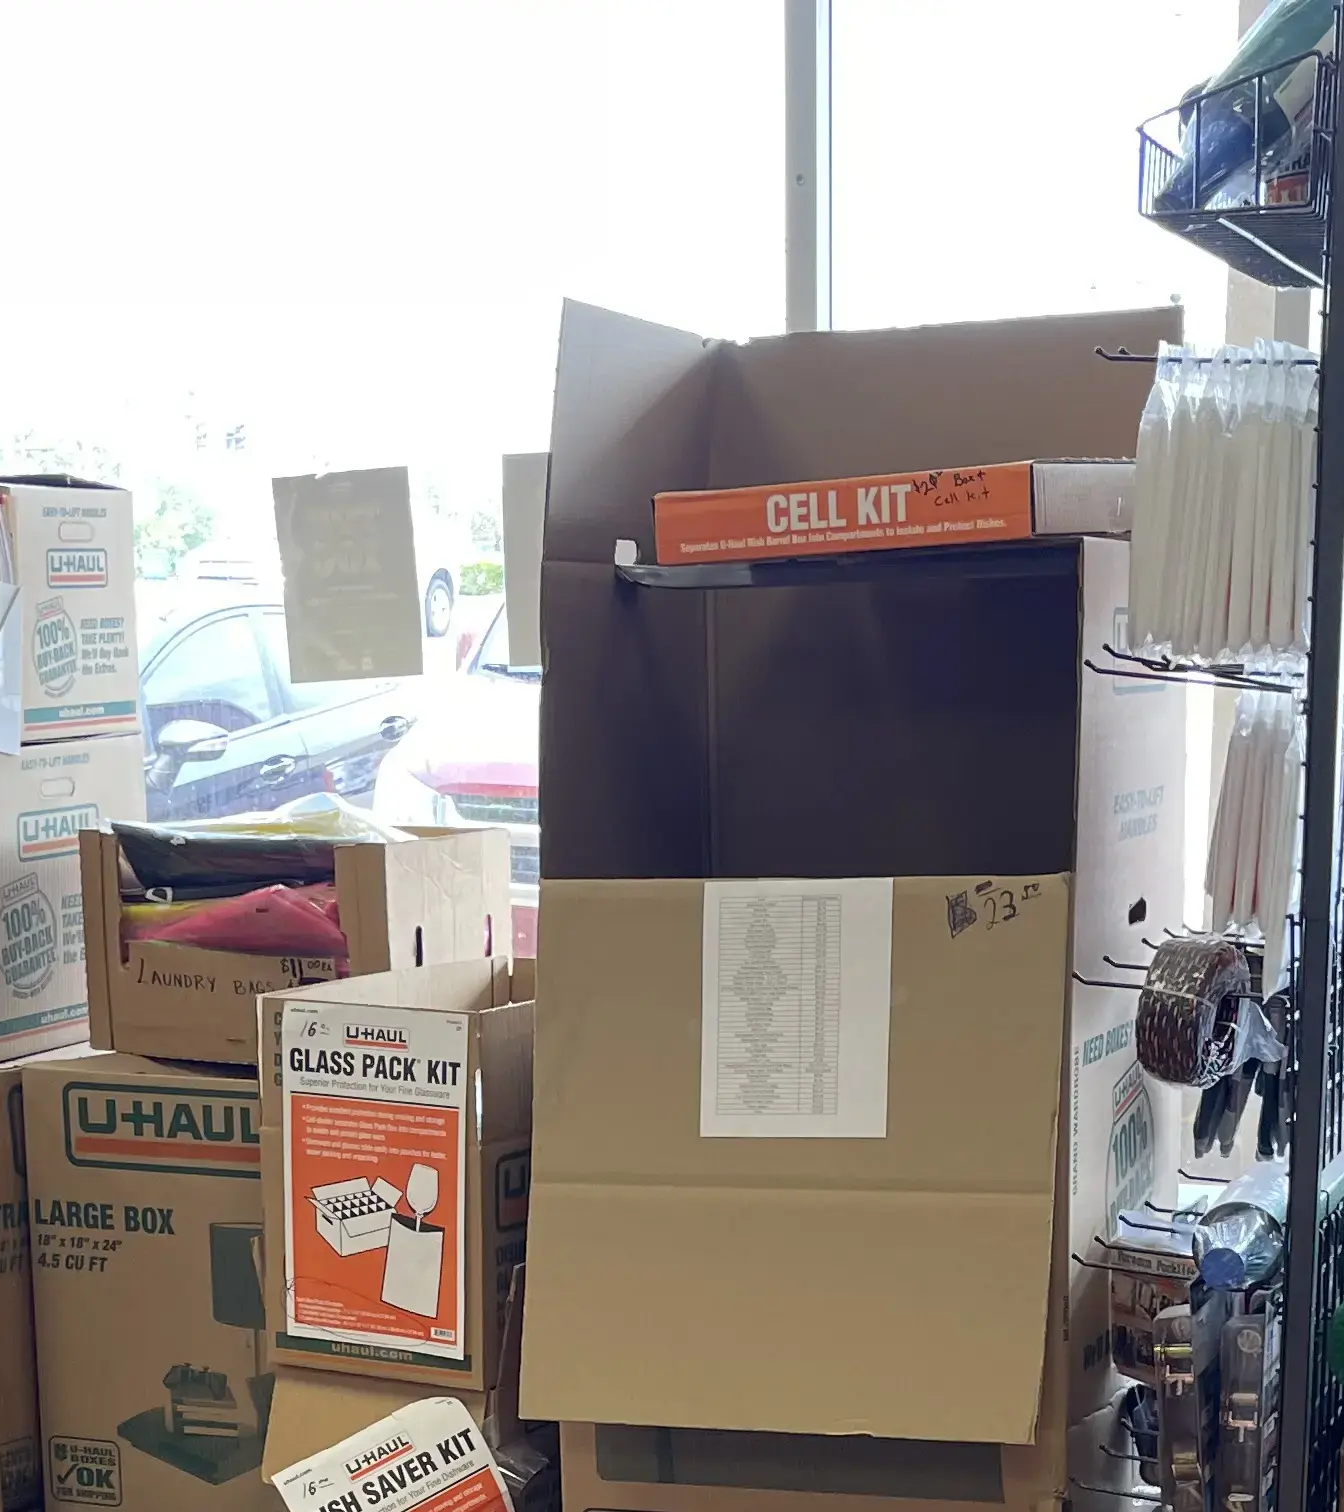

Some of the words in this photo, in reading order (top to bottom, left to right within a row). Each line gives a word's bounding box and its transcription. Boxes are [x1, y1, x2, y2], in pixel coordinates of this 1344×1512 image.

[766, 489, 847, 533] CELL
[856, 482, 912, 526] KIT
[50, 555, 104, 573] U-HAUL
[36, 617, 70, 649] 100%
[3, 898, 46, 941] 100%
[2, 926, 53, 965] BUY-BACK
[5, 947, 56, 985] GUARANTEE
[136, 957, 215, 992] LAUNDRY
[234, 980, 275, 995] BAGS
[345, 1025, 407, 1043] U-HAUL
[1082, 1034, 1104, 1067] NEED
[290, 1047, 355, 1076] GLASS
[362, 1053, 416, 1083] PACK
[427, 1060, 460, 1086] KIT
[299, 1076, 329, 1089] Superior
[332, 1078, 366, 1091] Protection
[369, 1083, 378, 1092] for
[380, 1084, 396, 1094] Your
[398, 1086, 413, 1096] Fine
[415, 1088, 450, 1099] Glassware
[77, 1096, 260, 1143] U-HAUL
[35, 1199, 115, 1230] LARGE
[124, 1206, 174, 1235] BOX
[37, 1253, 60, 1269] 4.5
[65, 1255, 84, 1270] CU
[89, 1256, 108, 1272] FT
[331, 1342, 413, 1361] uhaul.com
[70, 1445, 115, 1457] U-HAUL
[345, 1435, 410, 1475] U-HAUL
[362, 1451, 438, 1506] SAVER
[437, 1427, 476, 1465] KIT
[77, 1467, 115, 1489] OK
[397, 1494, 408, 1505] for
[409, 1486, 425, 1500] Your
[426, 1477, 442, 1493] Fine
